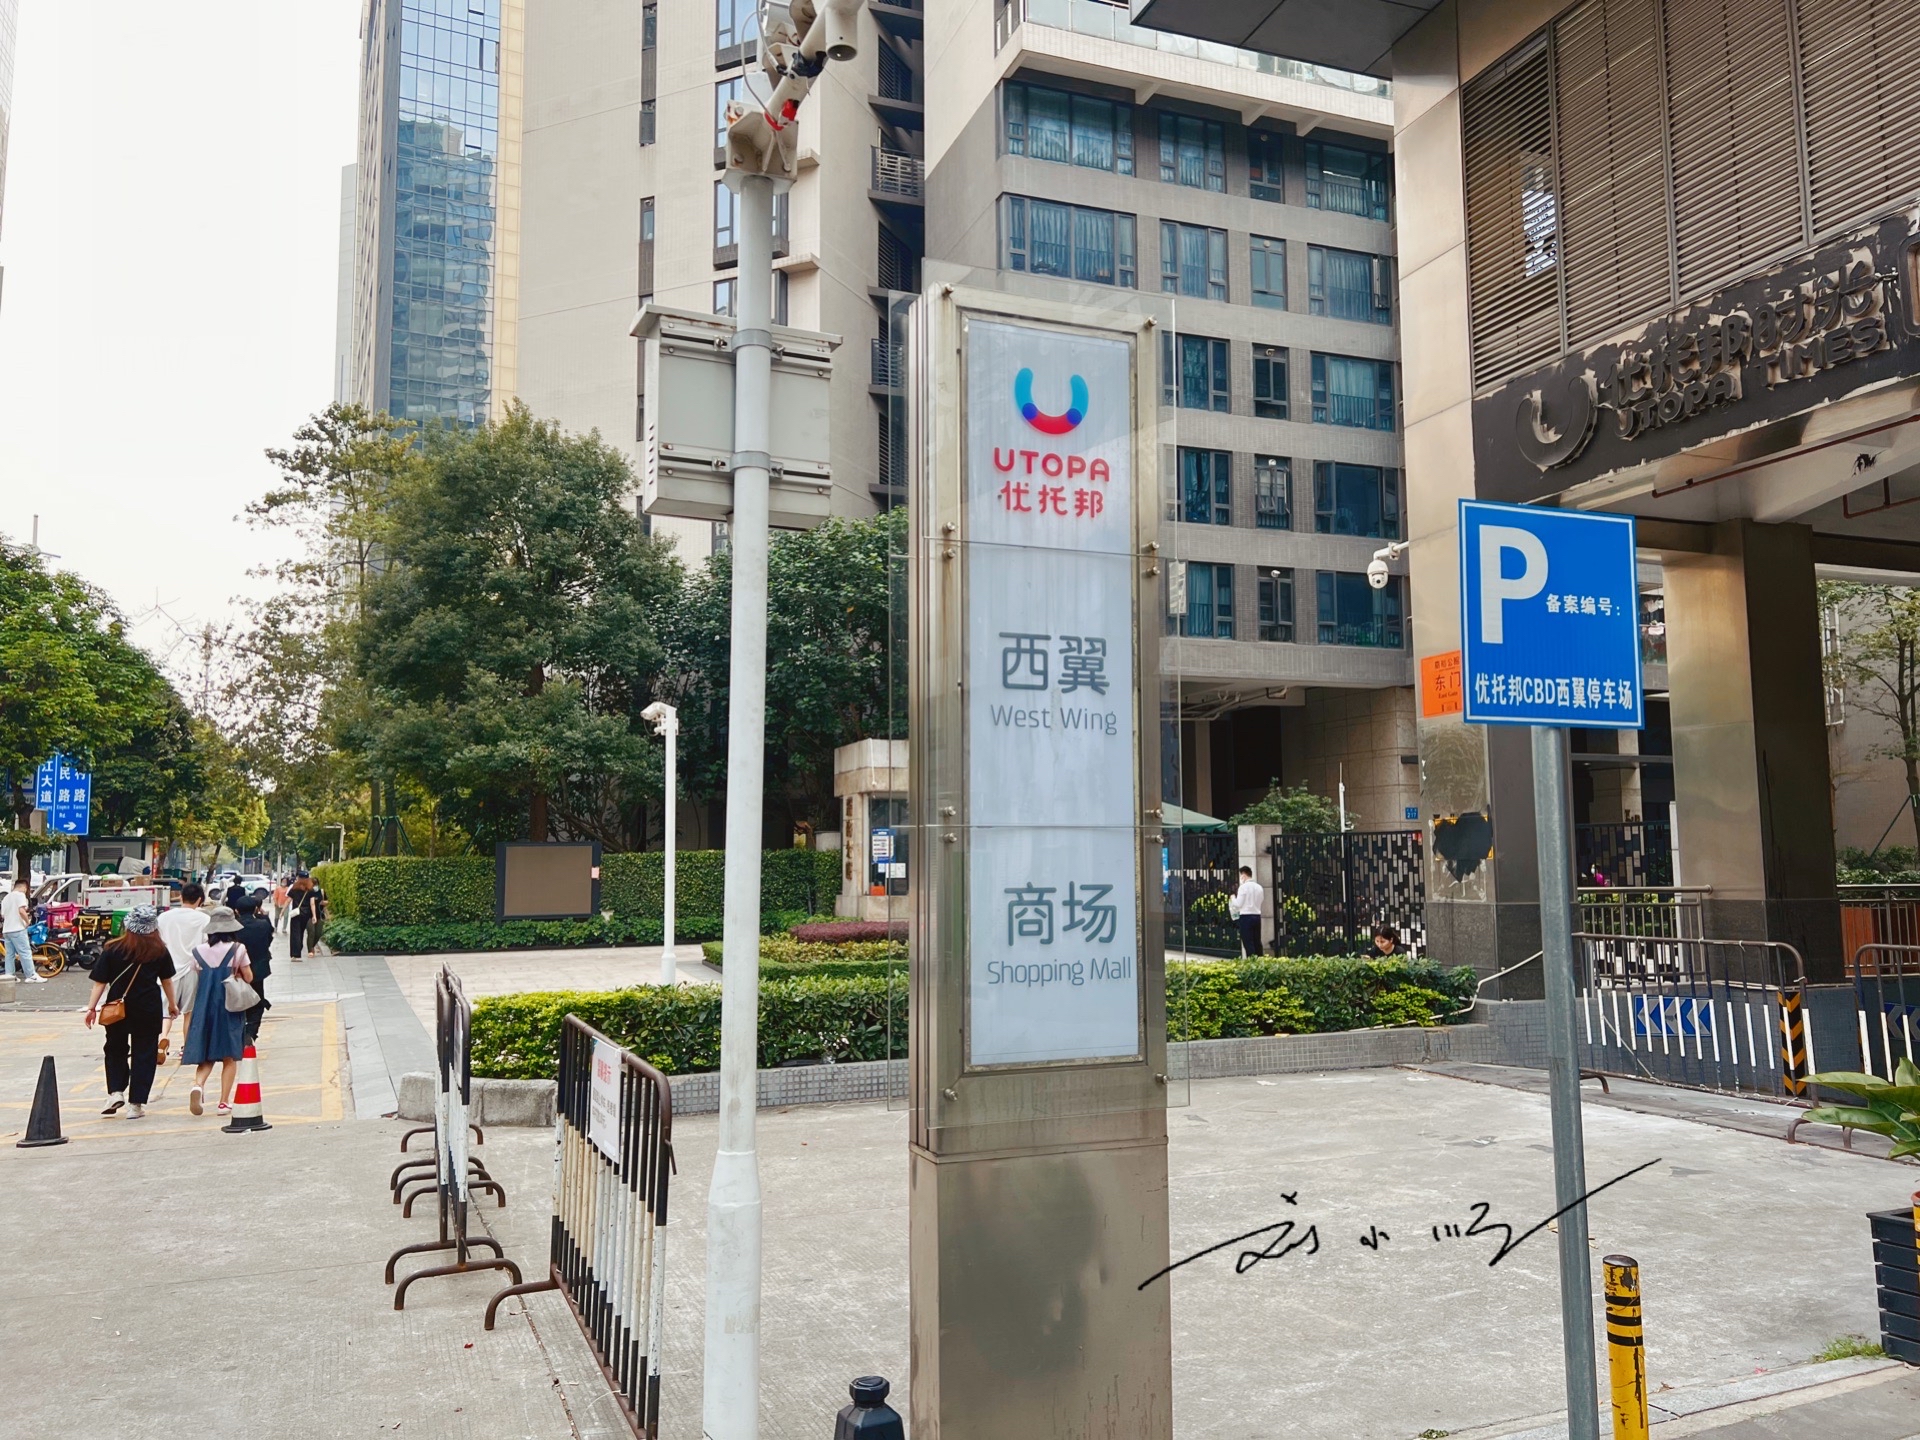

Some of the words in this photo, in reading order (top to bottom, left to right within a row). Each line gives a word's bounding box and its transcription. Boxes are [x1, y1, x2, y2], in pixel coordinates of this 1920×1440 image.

[1612, 371, 1743, 440] UTOPA
[1752, 317, 1884, 388] TIMES
[993, 447, 1110, 482] UTOPA
[1000, 480, 1104, 518] 优托邦
[1478, 524, 1549, 644] P
[998, 632, 1110, 695] 西翼
[1435, 671, 1461, 691] 东门
[1475, 672, 1633, 710] 优托邦CBD西翼停车场
[991, 704, 1052, 729] West
[1059, 707, 1118, 736] Wing
[1004, 881, 1118, 947] 商场
[988, 959, 1084, 987] Shopping
[1090, 956, 1131, 981] Mall
